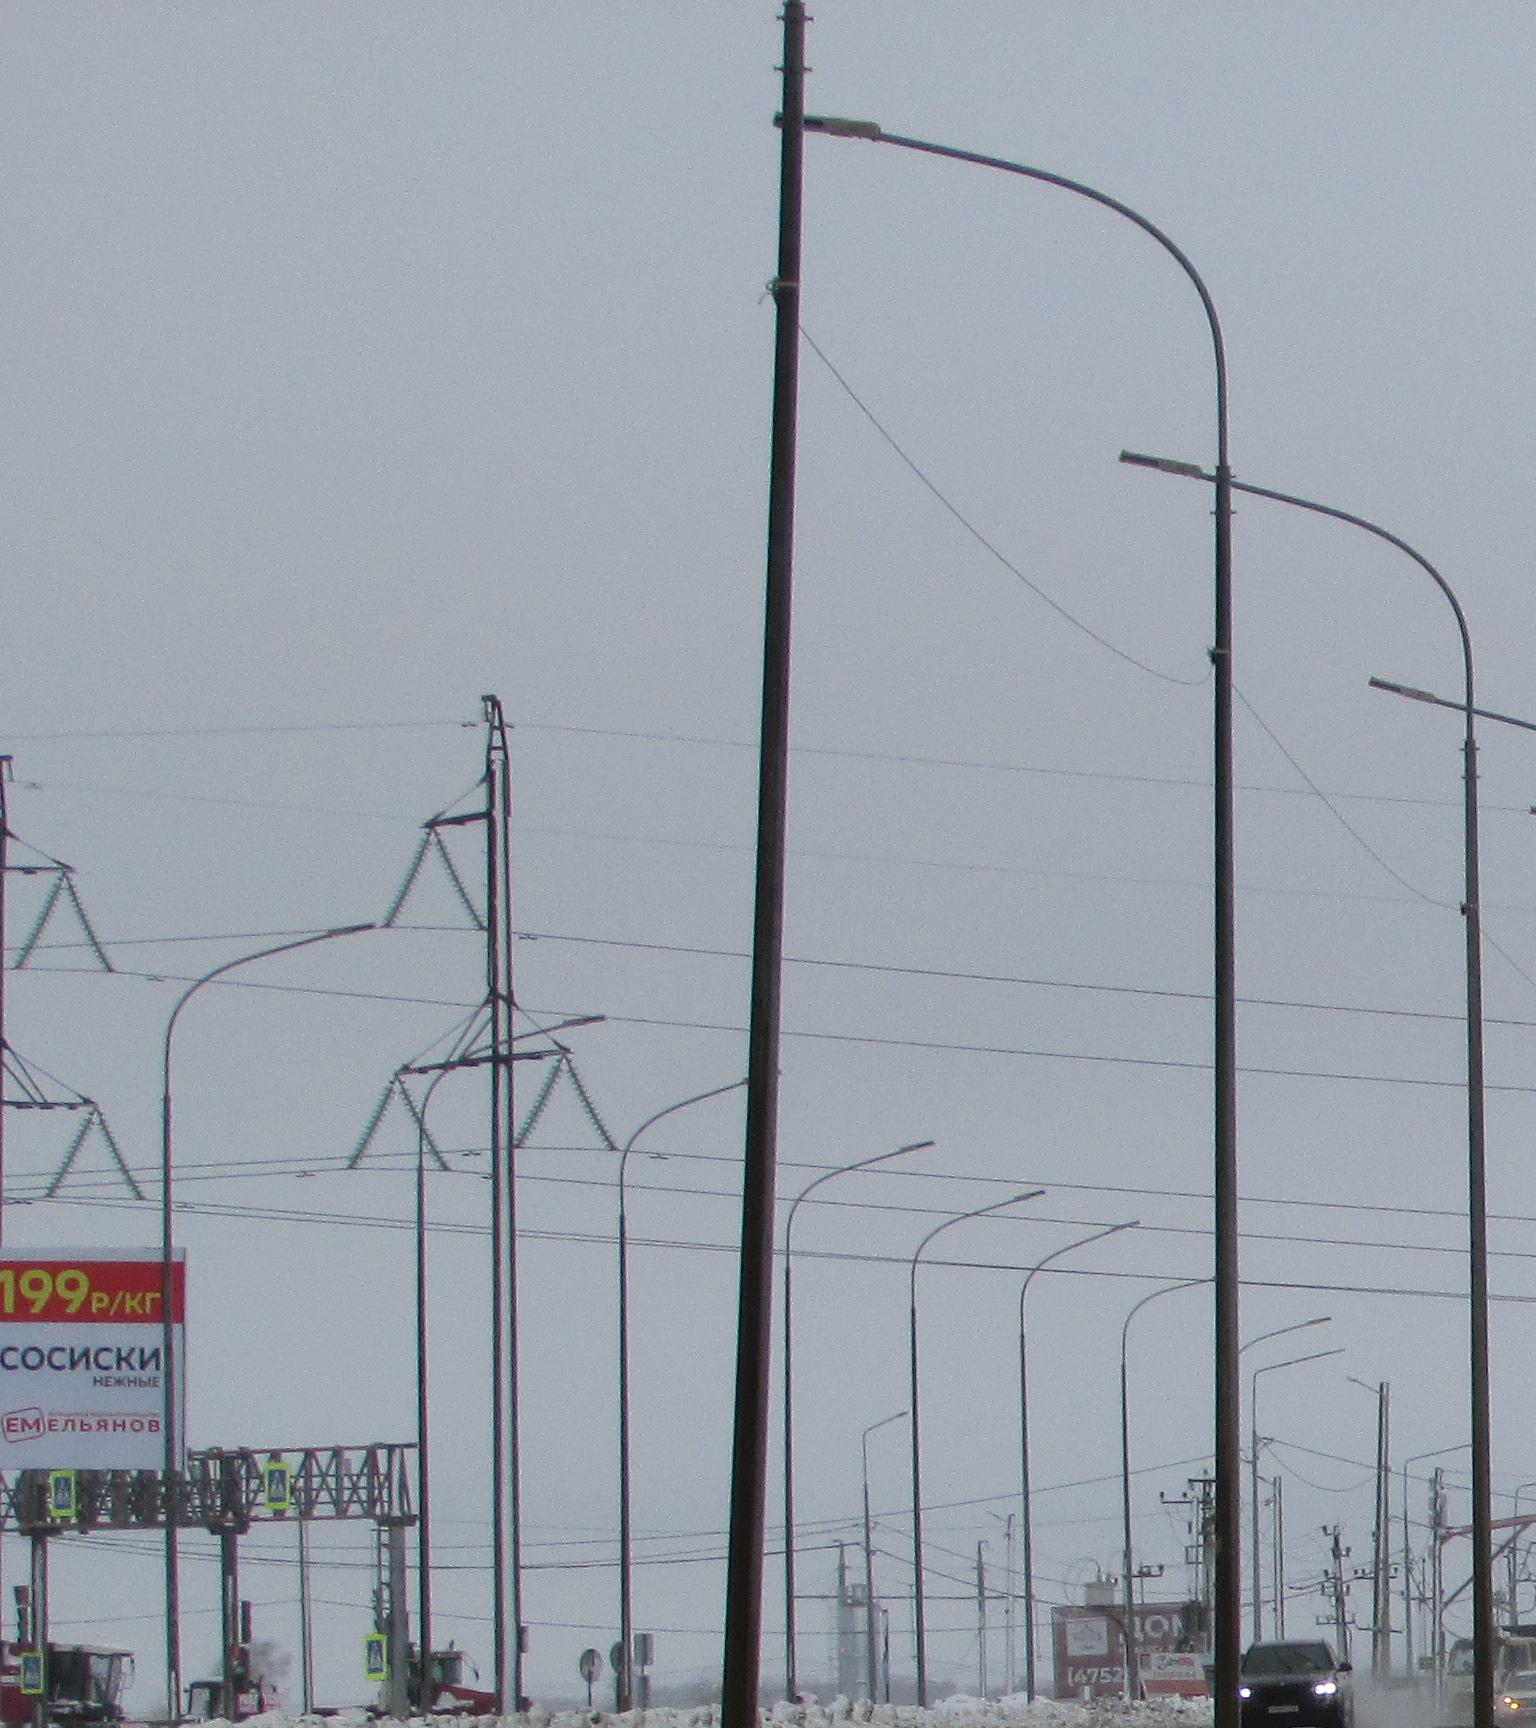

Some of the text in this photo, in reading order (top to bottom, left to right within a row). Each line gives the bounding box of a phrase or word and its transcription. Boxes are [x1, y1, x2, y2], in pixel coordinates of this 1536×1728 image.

[0, 1269, 90, 1314] 199
[0, 1346, 162, 1371] СОСИСКИ
[93, 1376, 161, 1388] НЕЖНЫЕ
